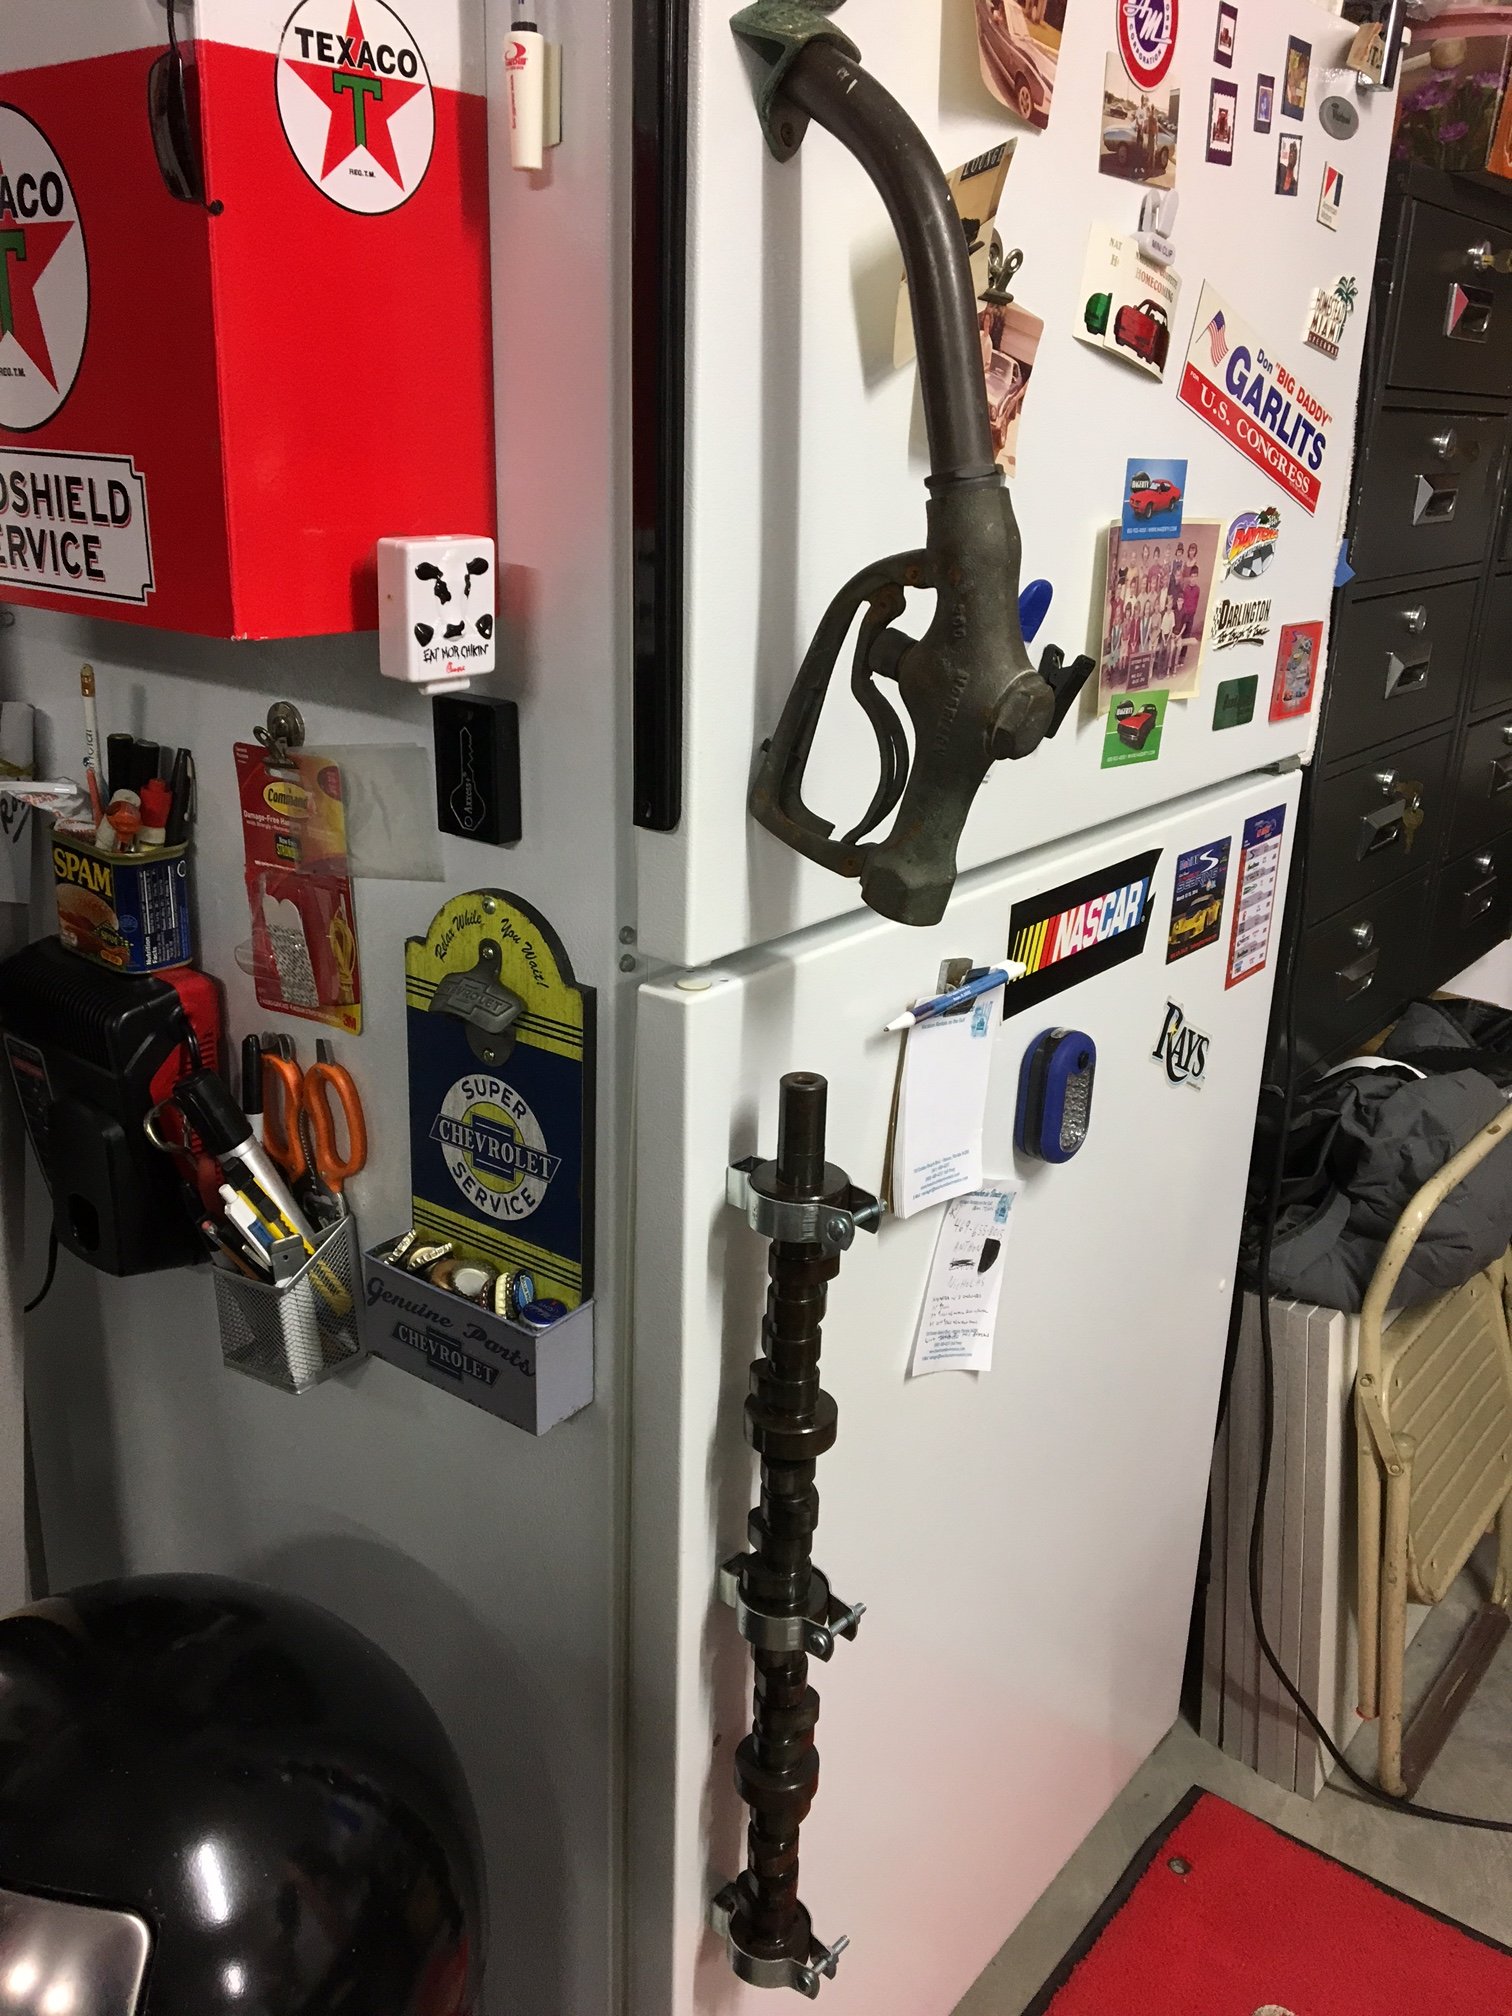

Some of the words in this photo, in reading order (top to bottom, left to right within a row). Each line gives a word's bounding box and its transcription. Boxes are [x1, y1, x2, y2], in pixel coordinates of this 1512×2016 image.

[294, 26, 418, 78] TEXACO
[1130, 23, 1162, 65] CORPORATION
[332, 70, 383, 149] T
[0, 171, 64, 218] ACO
[1162, 245, 1174, 258] CLIP
[1135, 267, 1174, 303] HOMECOMING
[1310, 313, 1341, 344] MIAMI
[1190, 371, 1200, 382] FOR
[1257, 348, 1274, 374] Don
[1275, 362, 1296, 395] "BIG
[1296, 387, 1333, 427] DADDY"
[1225, 346, 1326, 471] GARLITS
[1201, 383, 1230, 426] U.S.
[1236, 418, 1310, 494] CONGRESS
[0, 523, 106, 583] RVICE
[1218, 599, 1271, 630] DARLINGTON
[423, 647, 439, 663] EAT
[441, 645, 460, 660] MOR
[461, 644, 489, 659] CHIKIN
[53, 847, 112, 897] SPAM
[435, 928, 456, 963] Relax
[452, 910, 484, 932] While
[1051, 880, 1144, 963] NASCAR
[501, 918, 522, 944] You
[521, 942, 550, 989] Wait!
[342, 1012, 357, 1032] 3M
[1152, 1001, 1210, 1082] RAYS
[461, 1078, 527, 1120] SUPER
[438, 1118, 552, 1179] CHEVROLET
[451, 1161, 536, 1216] SERVICE
[366, 1277, 454, 1328] Genuine
[462, 1322, 537, 1377] Parts
[398, 1324, 495, 1385] CHEVROLET
